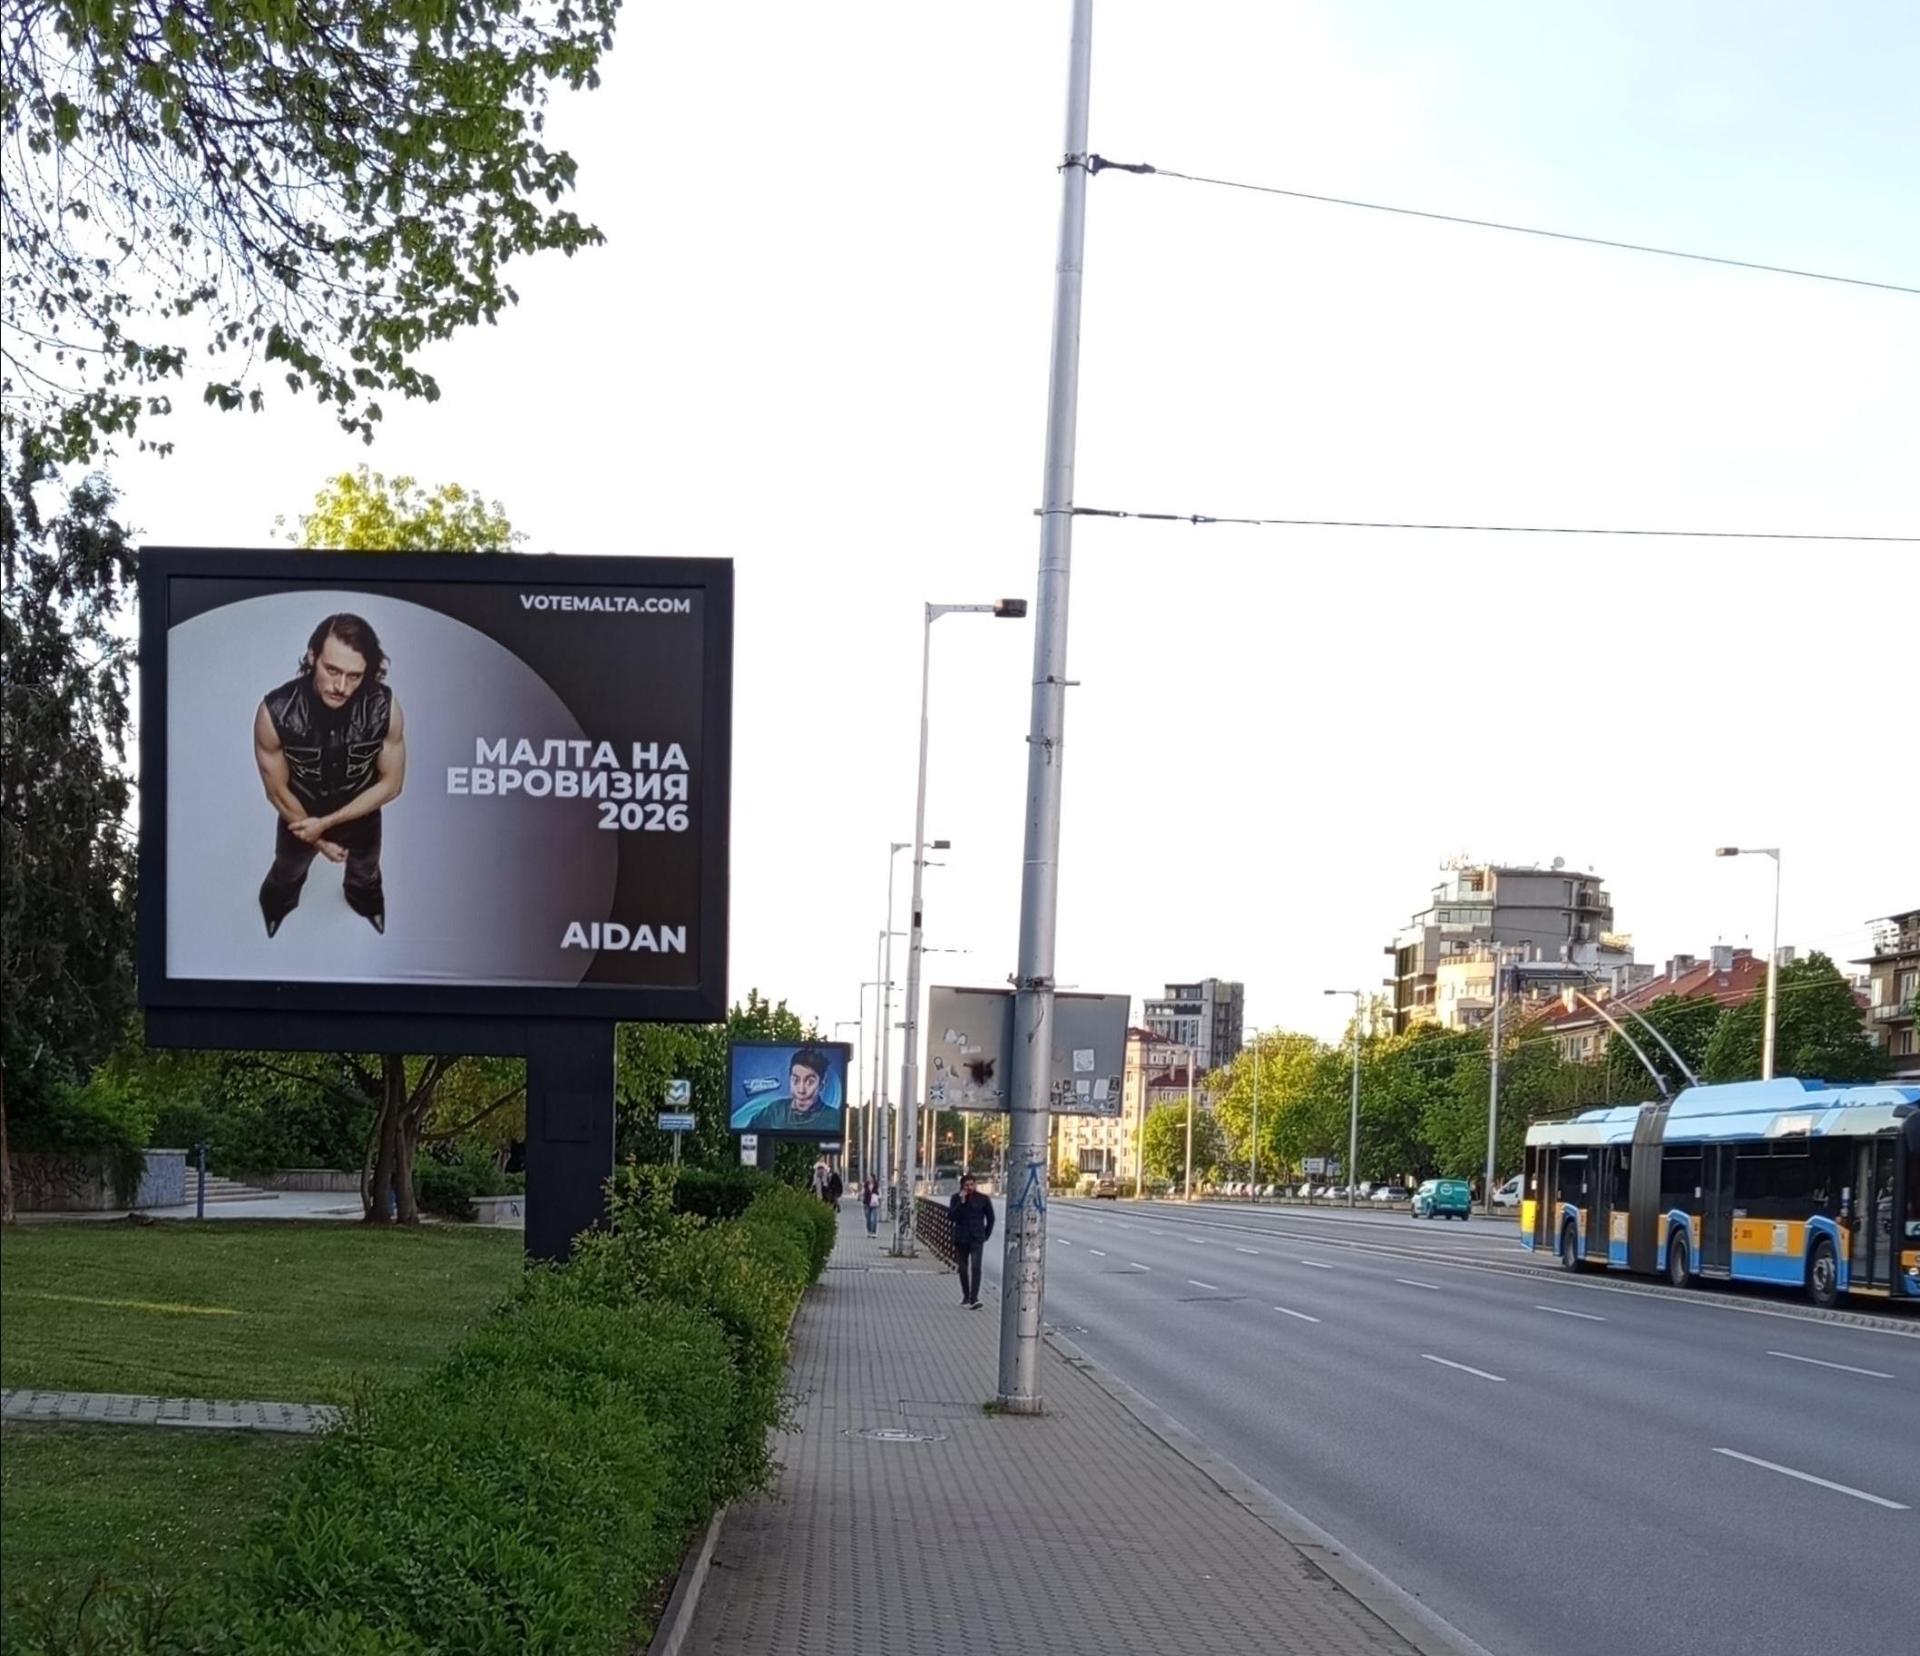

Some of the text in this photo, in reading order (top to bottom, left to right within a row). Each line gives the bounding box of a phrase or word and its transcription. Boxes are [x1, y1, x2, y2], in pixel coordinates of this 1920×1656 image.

[520, 594, 690, 613] VOTEMALTA.COM
[475, 737, 689, 770] МАЛТА НА
[447, 766, 689, 801] ЕВРОВИЗИЯ
[598, 801, 689, 831] 2026
[560, 922, 686, 953] AIDAN
